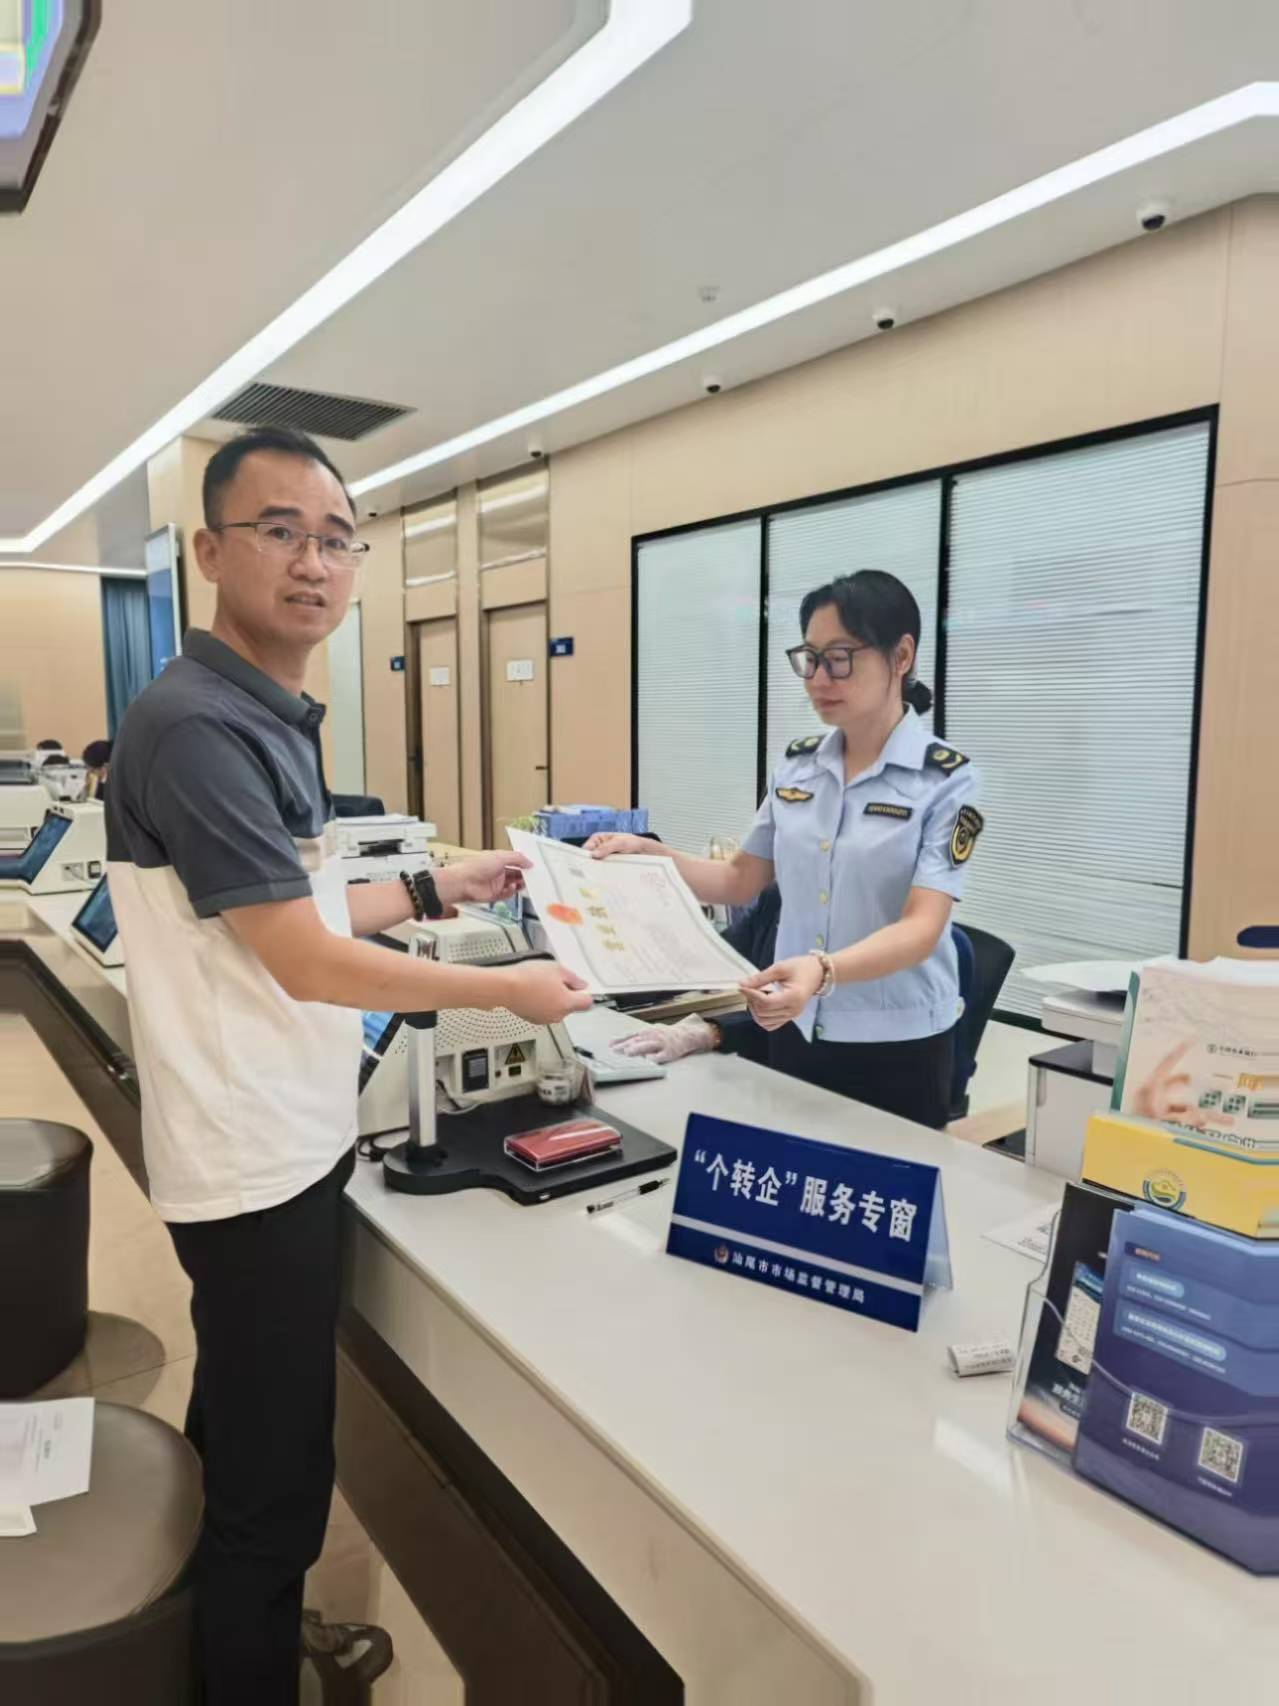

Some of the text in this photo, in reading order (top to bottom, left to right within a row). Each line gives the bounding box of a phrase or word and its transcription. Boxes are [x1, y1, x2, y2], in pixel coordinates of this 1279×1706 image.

[694, 1149, 917, 1241] “个转企”服务专窗
[732, 1251, 865, 1303] 汕尾市市场监督管理局
